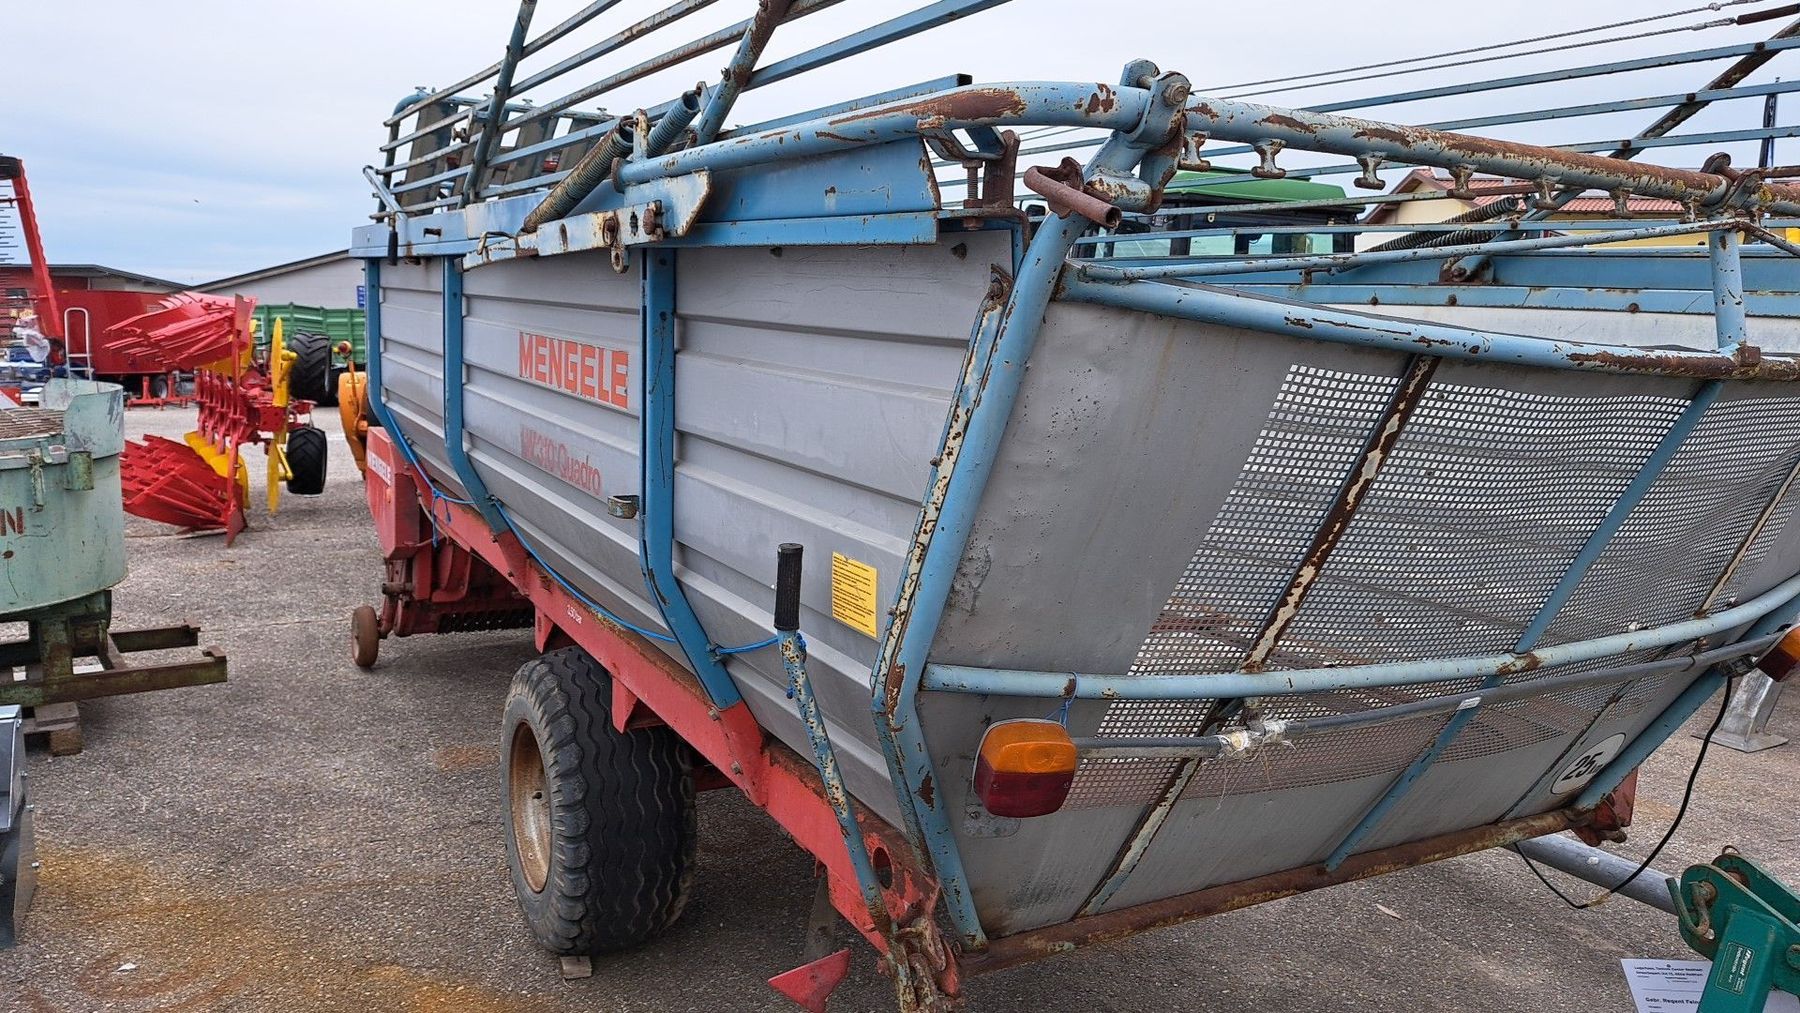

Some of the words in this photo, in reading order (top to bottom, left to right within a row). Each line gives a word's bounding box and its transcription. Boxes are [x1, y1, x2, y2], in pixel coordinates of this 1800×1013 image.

[519, 332, 629, 409] MENGELE
[558, 442, 602, 496] Quadro
[1561, 751, 1604, 781] 25
